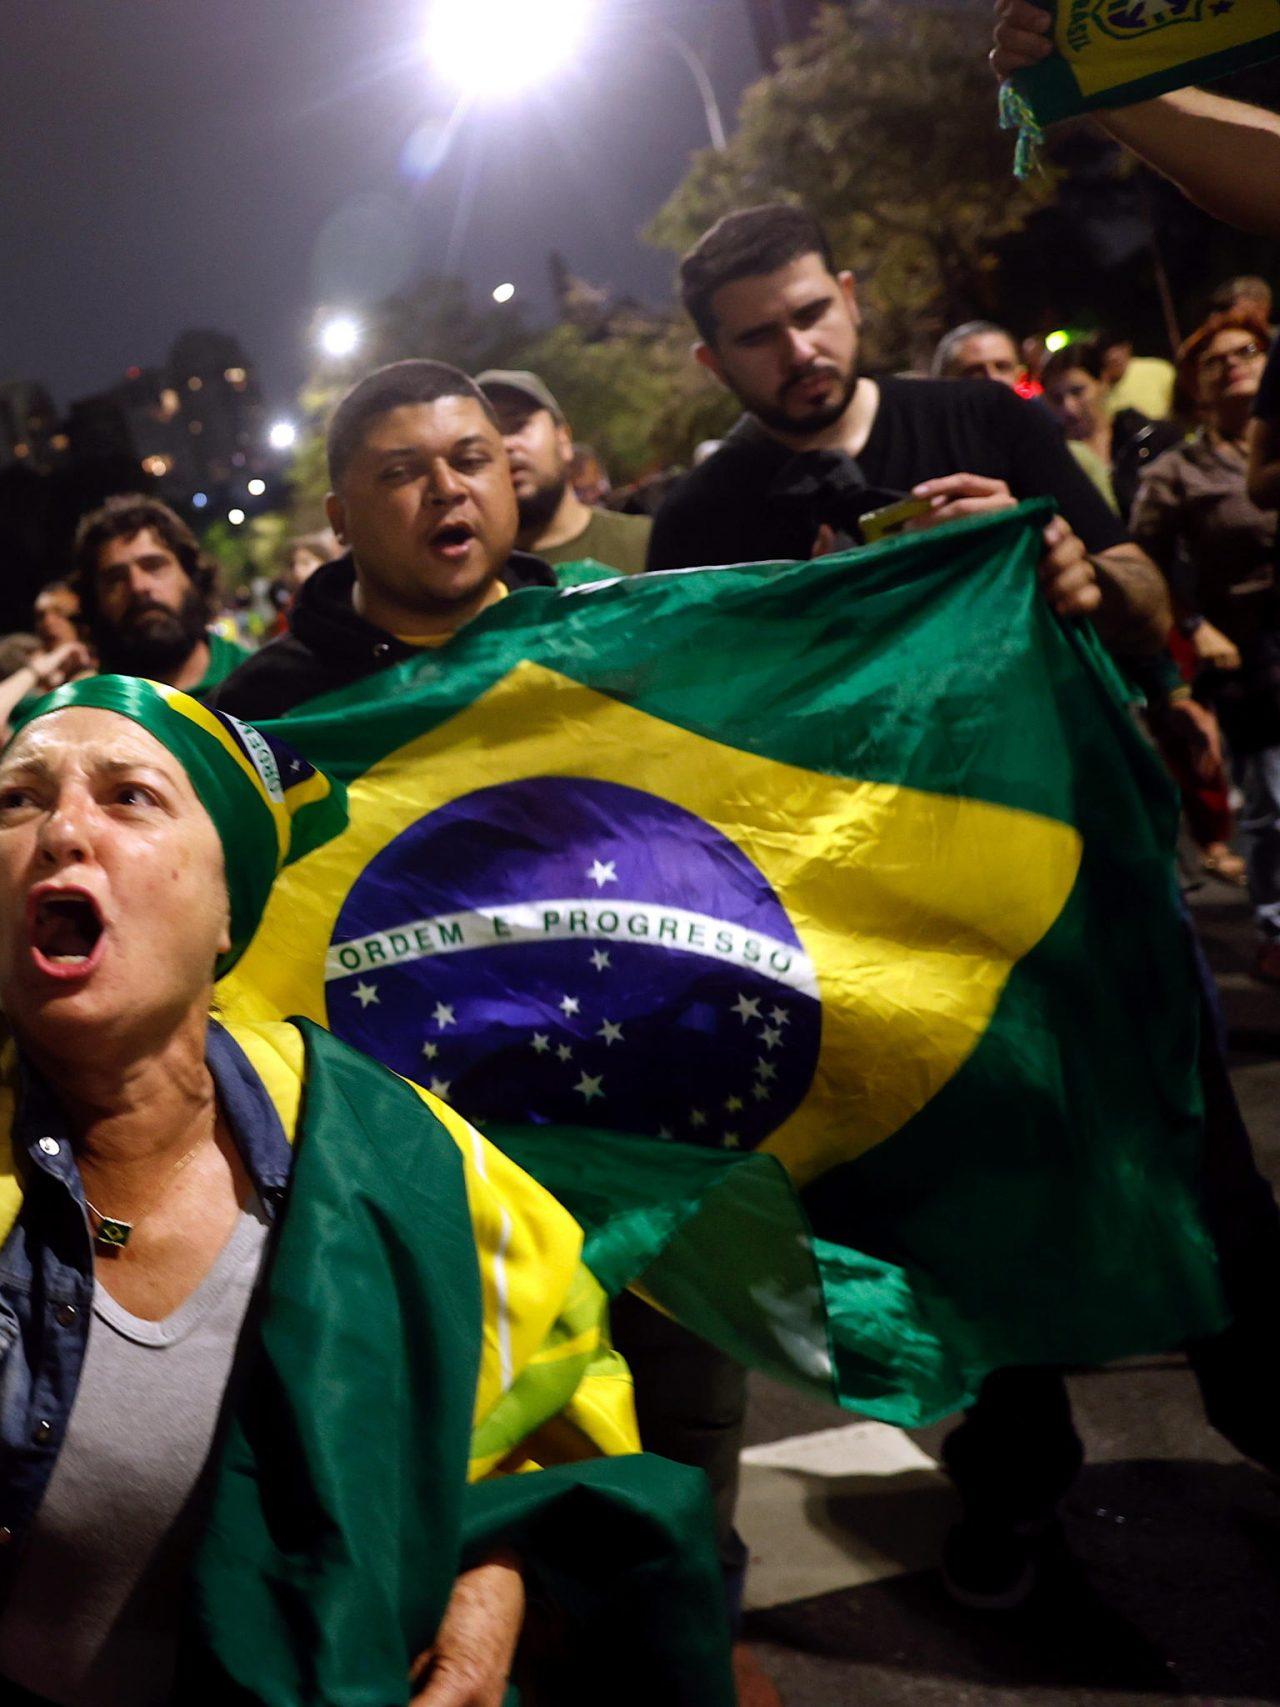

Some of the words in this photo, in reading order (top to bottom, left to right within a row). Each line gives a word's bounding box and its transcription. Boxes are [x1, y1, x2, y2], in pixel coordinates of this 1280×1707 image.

[339, 921, 464, 970] ORDEM
[492, 914, 512, 938] E
[543, 910, 793, 974] PROGRESSO
